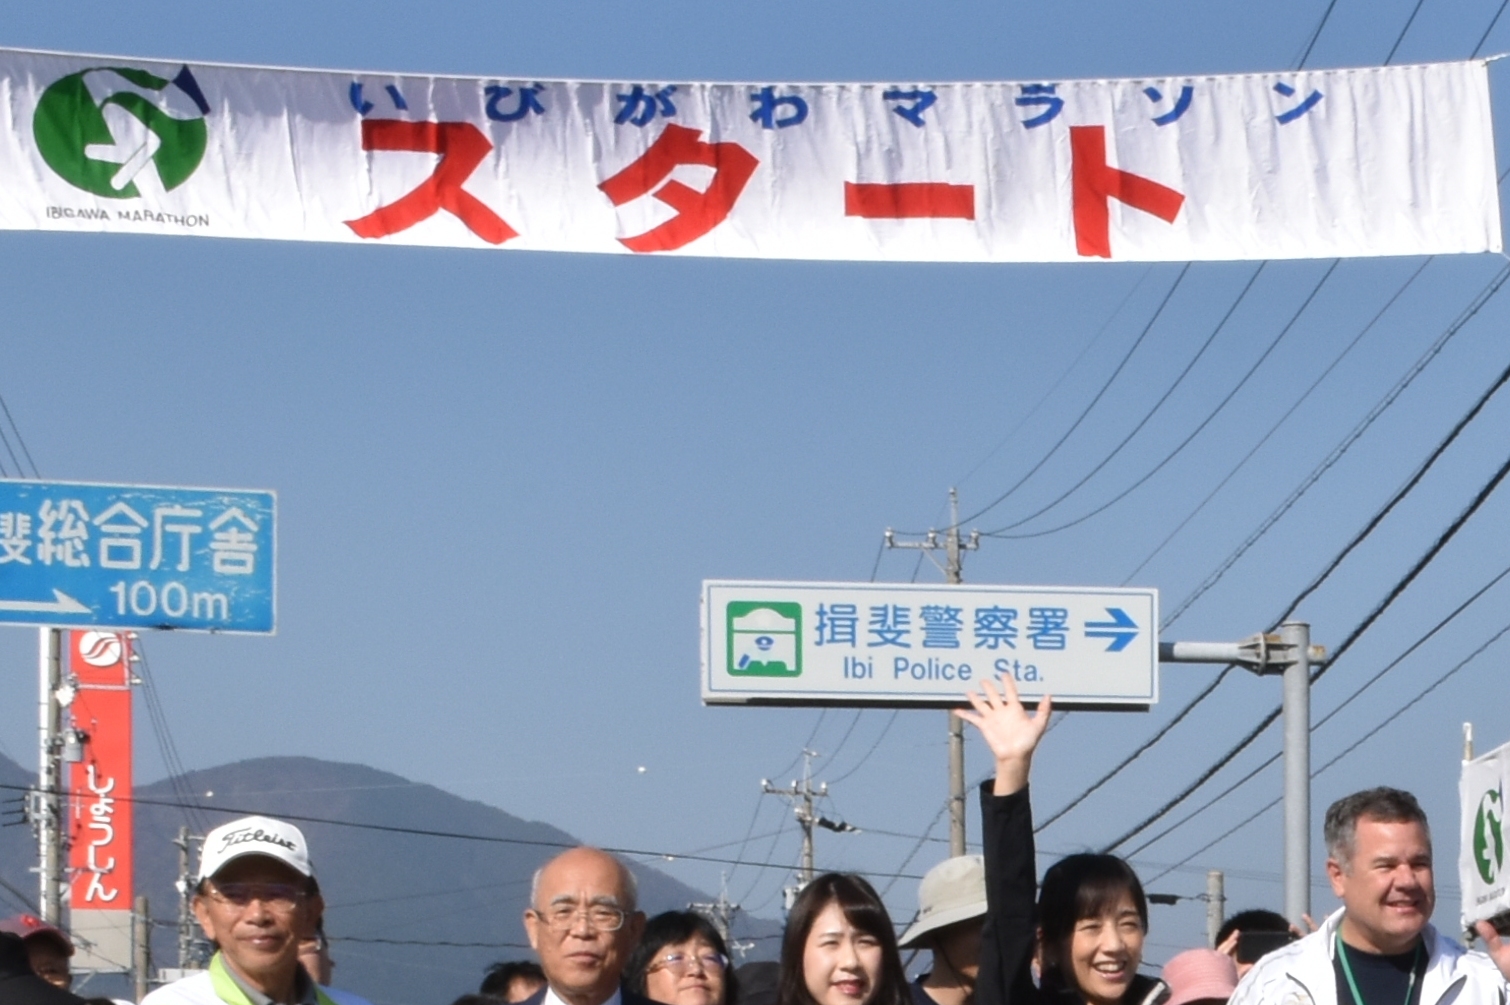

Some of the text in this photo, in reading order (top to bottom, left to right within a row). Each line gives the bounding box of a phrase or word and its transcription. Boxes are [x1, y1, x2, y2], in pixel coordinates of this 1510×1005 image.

[349, 81, 1324, 129] いびがわマラソン
[343, 118, 1187, 259] スタート
[46, 205, 210, 228] IBIGAWA MARATHON
[109, 580, 229, 620] 100m
[813, 603, 1070, 651] 揖斐警察署
[843, 656, 1045, 682] Ibi Police Sta.
